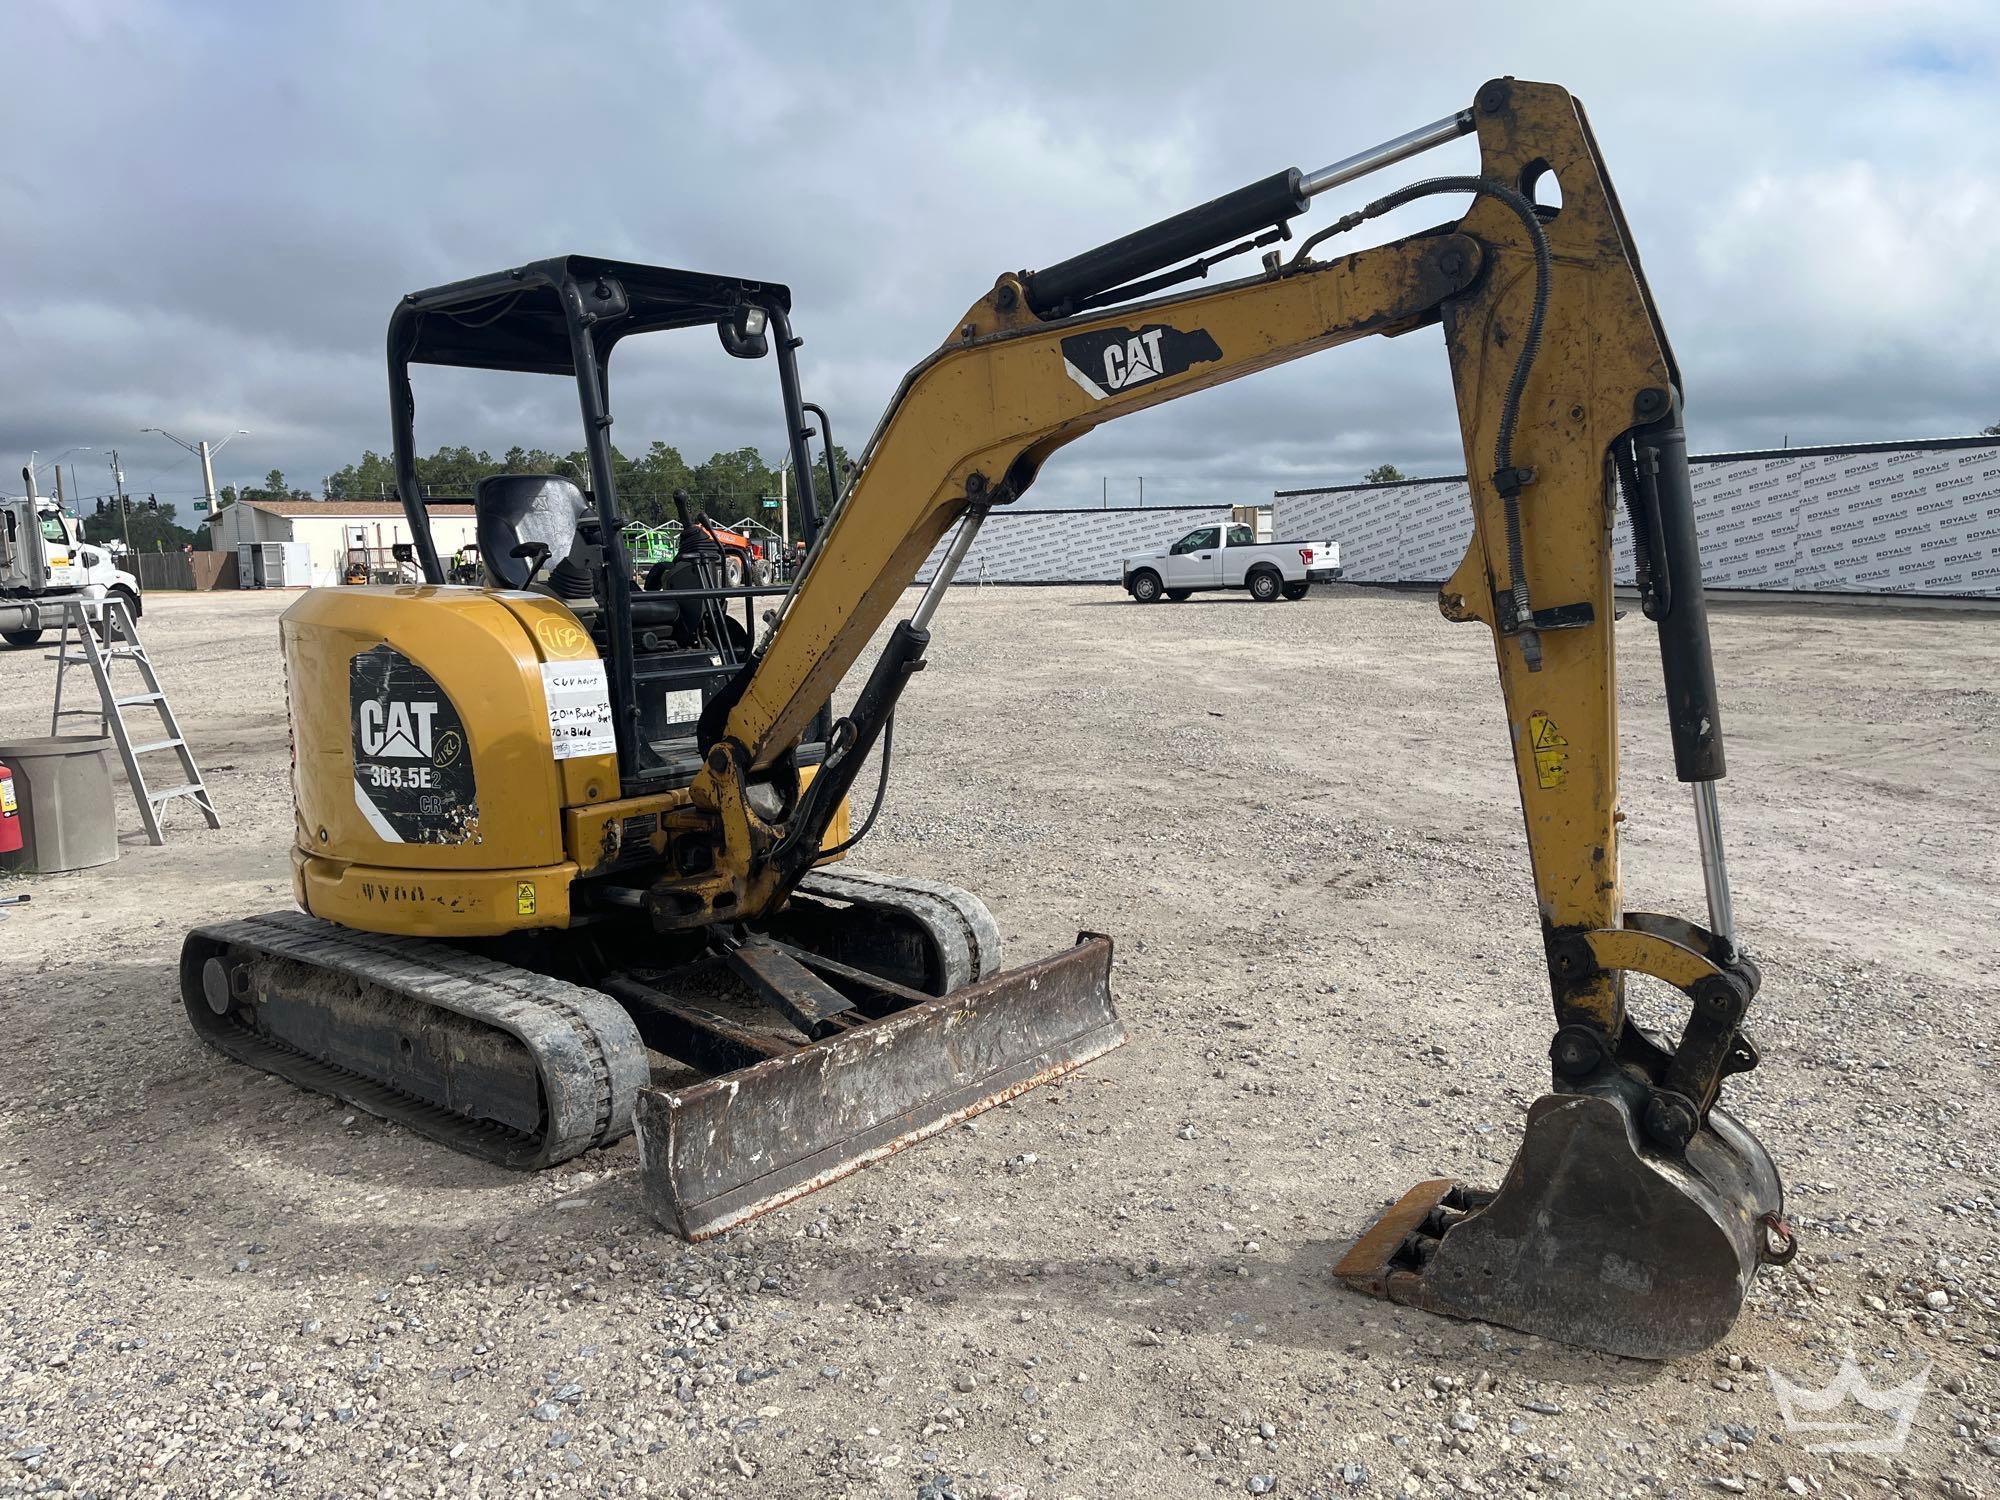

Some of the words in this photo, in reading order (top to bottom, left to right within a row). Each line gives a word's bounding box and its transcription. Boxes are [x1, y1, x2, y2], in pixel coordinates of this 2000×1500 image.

[1103, 328, 1164, 390] CAT
[1887, 452, 1915, 463] ROYAL
[1959, 452, 1988, 464] ROYAL
[1765, 459, 1788, 468] ROYAL
[1845, 464, 1870, 474] ROYAL
[1913, 465, 1941, 475] ROYAL
[1728, 470, 1750, 479] ROYAL
[1694, 480, 1714, 489] ROYAL
[1749, 480, 1772, 490] ROYAL
[1804, 476, 1829, 485] ROYAL
[1869, 476, 1896, 486] ROYAL
[1936, 478, 1965, 488] ROYAL
[1713, 491, 1735, 499] ROYAL
[1827, 487, 1853, 497] ROYAL
[1891, 489, 1919, 499] ROYAL
[1963, 490, 1992, 502] ROYAL
[1768, 493, 1791, 502] ROYAL
[1732, 502, 1753, 511] ROYAL
[1848, 500, 1874, 509] ROYAL
[1917, 502, 1945, 512] ROYAL
[1697, 512, 1717, 520] ROYAL
[1752, 514, 1774, 522] ROYAL
[1808, 510, 1832, 519] ROYAL
[1873, 512, 1900, 522] ROYAL
[1940, 516, 1968, 525] ROYAL
[1716, 523, 1737, 531] ROYAL
[1771, 526, 1794, 534] ROYAL
[1831, 522, 1856, 531] ROYAL
[1895, 526, 1923, 535] ROYAL
[1734, 535, 1758, 543] ROYAL
[1967, 530, 1997, 539] ROYAL
[1852, 536, 1878, 544] ROYAL
[1921, 539, 1949, 548] ROYAL
[1700, 543, 1721, 551] ROYAL
[1756, 546, 1779, 555] ROYAL
[1811, 544, 1836, 553] ROYAL
[1876, 548, 1904, 557] ROYAL
[1834, 557, 1860, 566] ROYAL
[1944, 553, 1973, 562] ROYAL
[1775, 559, 1796, 568] ROYA
[1899, 563, 1927, 571] ROYAL
[1738, 567, 1760, 575] ROYAL
[1795, 565, 1819, 573] ROYAL
[1856, 571, 1882, 579] ROYAL
[1814, 579, 1840, 587] ROYAL
[1925, 576, 1954, 585] ROYAL
[360, 700, 438, 758] CAT
[420, 796, 442, 814] CR
